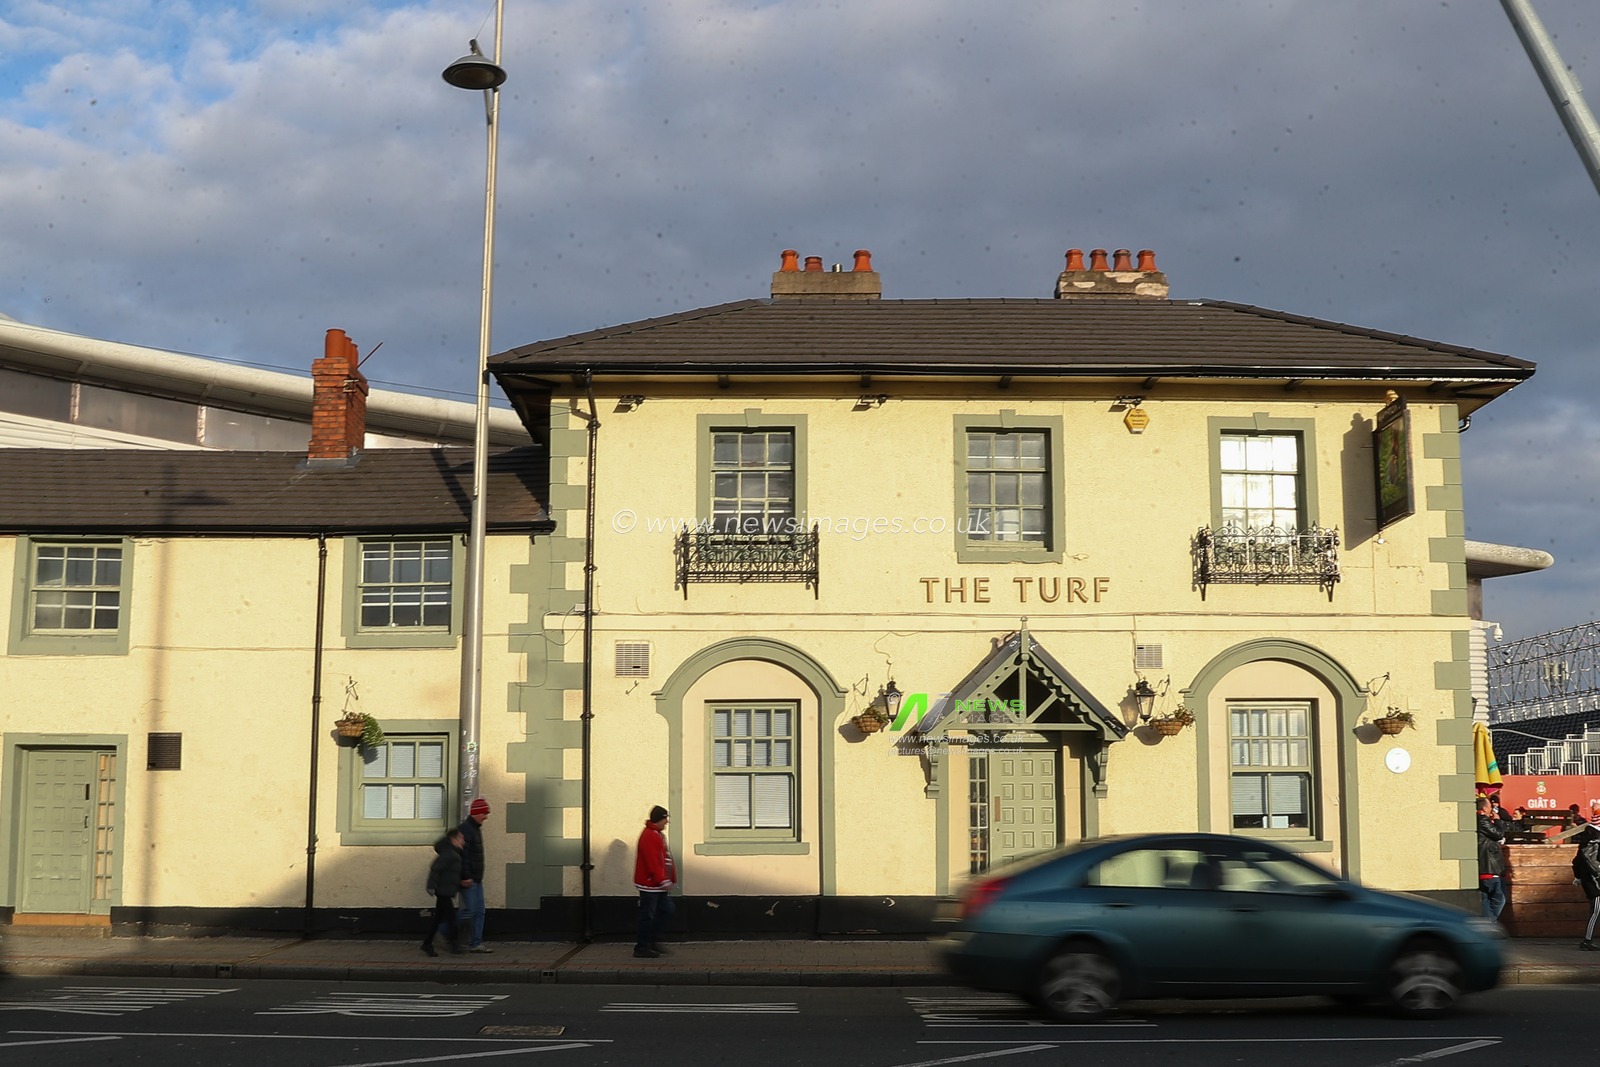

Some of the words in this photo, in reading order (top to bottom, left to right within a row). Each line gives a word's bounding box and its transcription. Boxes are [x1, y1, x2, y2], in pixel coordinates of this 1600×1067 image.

[919, 576, 991, 603] THE
[1013, 576, 1110, 604] TURF
[1527, 797, 1548, 808] GIÂT
[1549, 799, 1557, 808] 8
